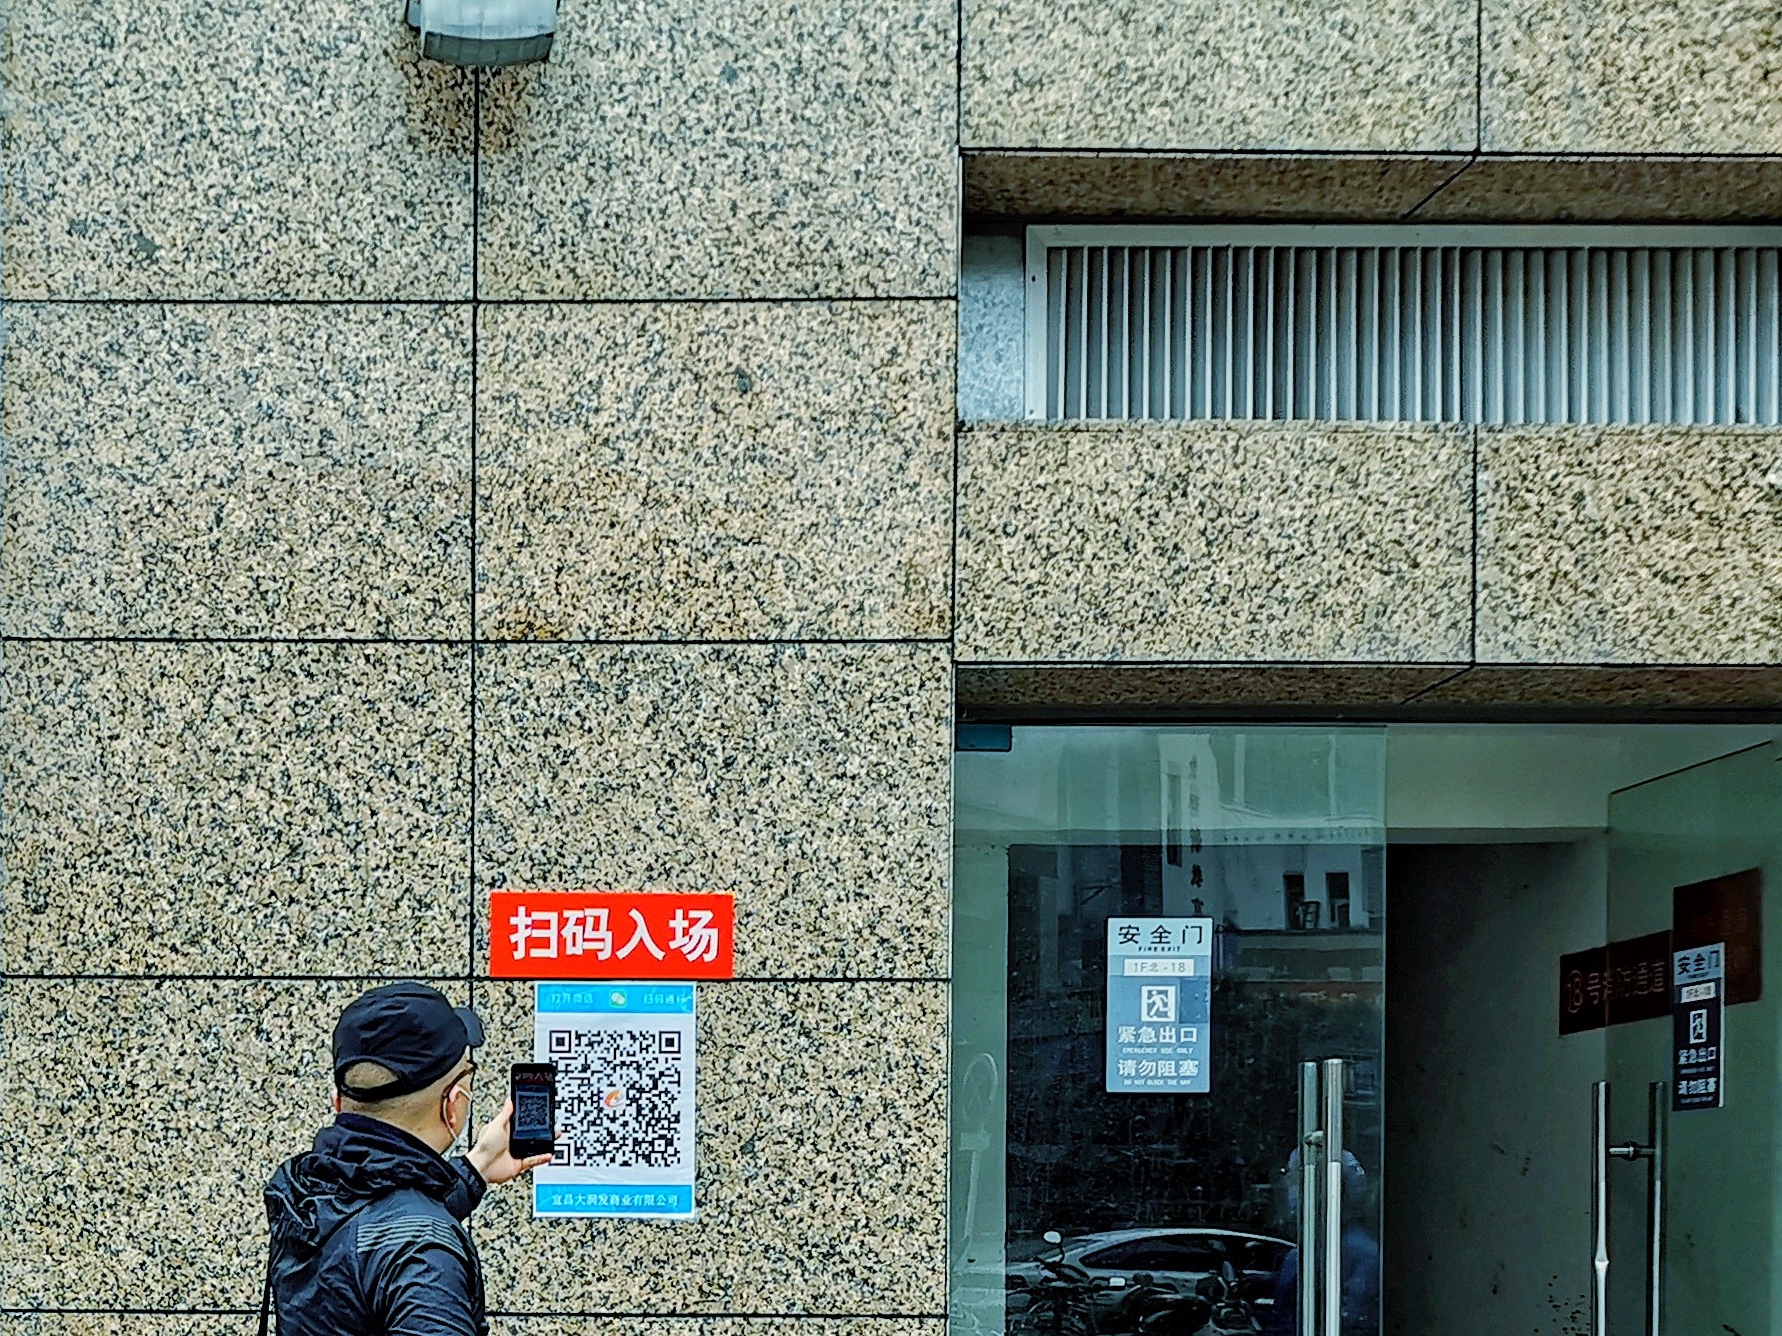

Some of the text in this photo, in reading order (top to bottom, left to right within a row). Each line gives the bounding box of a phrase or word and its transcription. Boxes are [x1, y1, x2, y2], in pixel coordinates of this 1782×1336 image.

[509, 905, 719, 962] 扫码入场
[1117, 924, 1203, 945] 安全门
[1677, 949, 1720, 975] 安全门
[1118, 1026, 1198, 1044] 紧急出口
[1118, 1059, 1199, 1077] 请勿阻塞
[552, 1193, 678, 1207] 宜昌大润发商业有限公司
